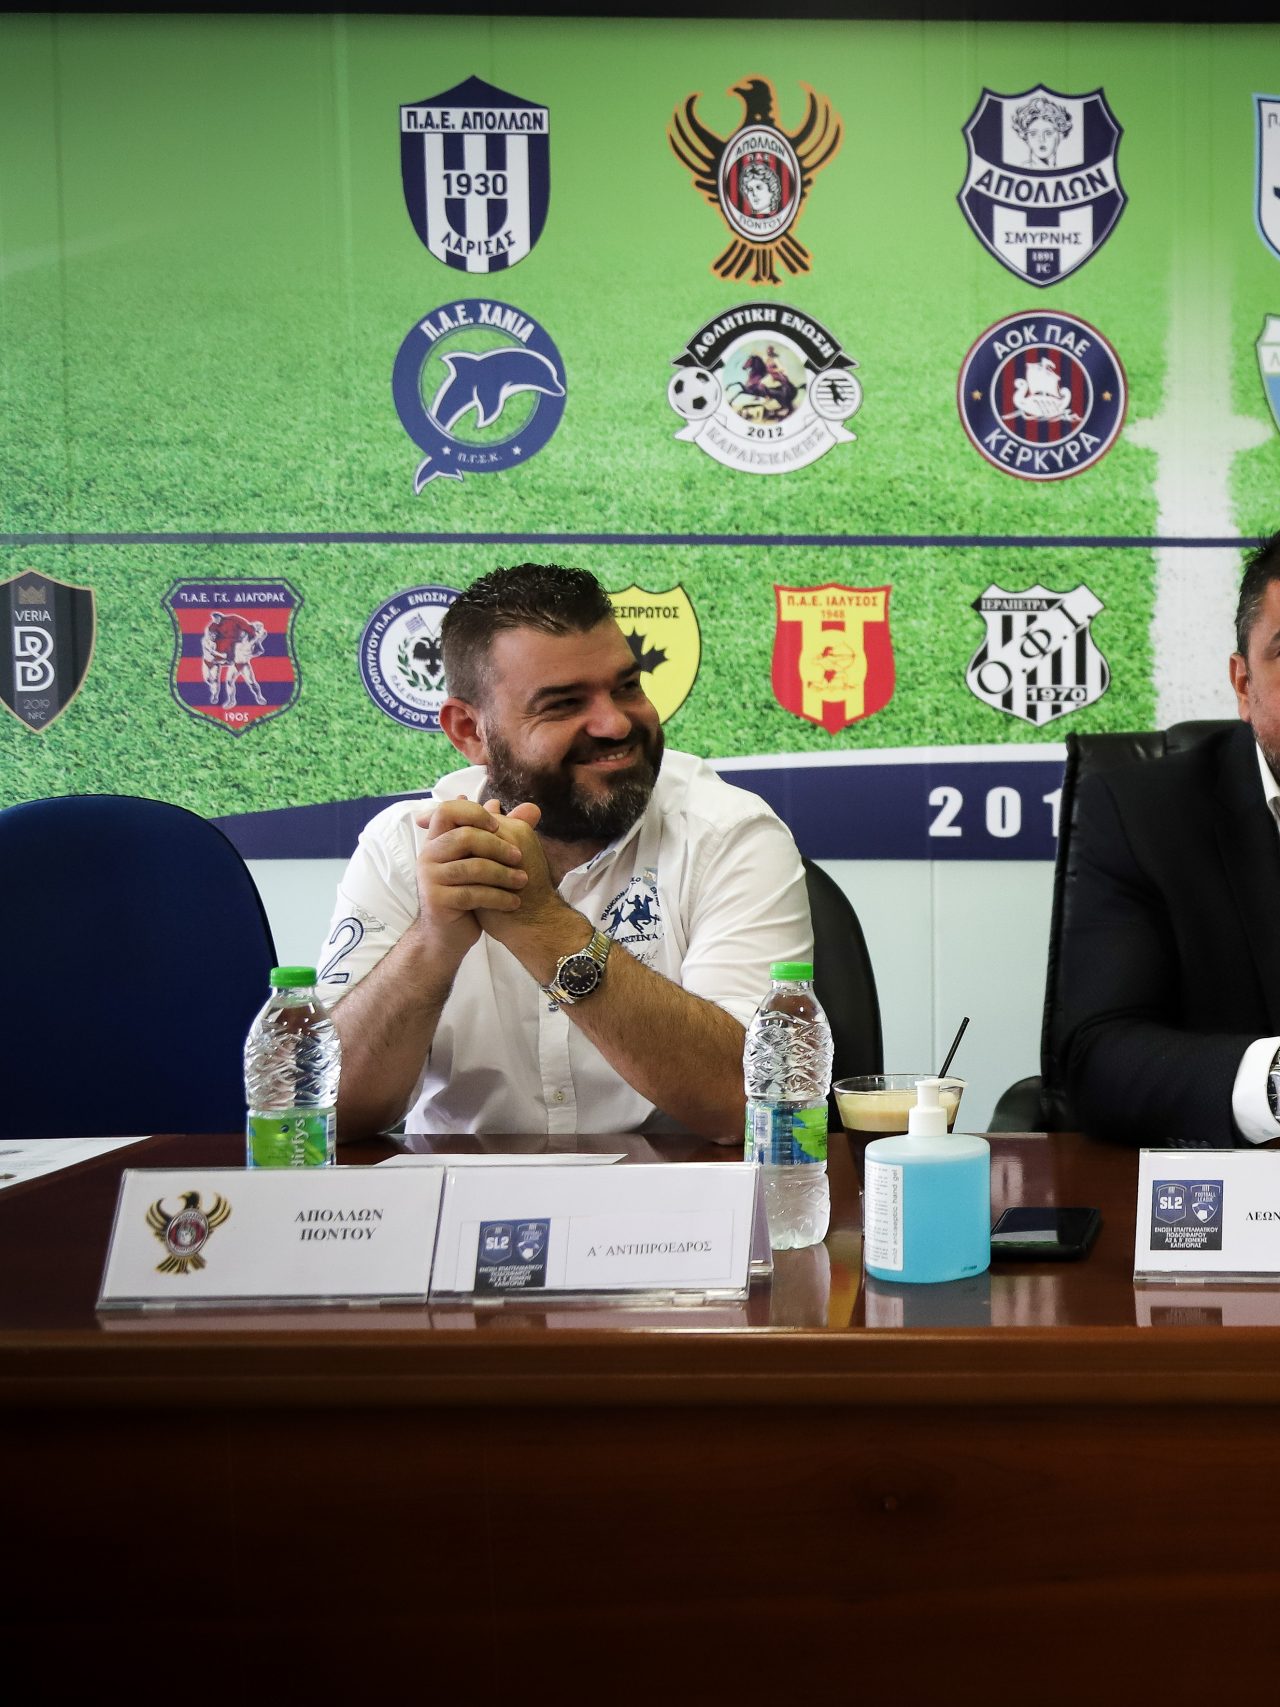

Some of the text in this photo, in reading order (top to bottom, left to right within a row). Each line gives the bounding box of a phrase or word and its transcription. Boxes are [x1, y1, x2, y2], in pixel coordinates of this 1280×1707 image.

[407, 111, 544, 130] Π.Α.Ε. ΑΠΟΛΛΩΝ
[736, 137, 785, 157] ΑΠΟΛΛΩΝ
[443, 173, 507, 196] 1930
[975, 168, 1109, 203] ΑΠΟΛΛΩΝ
[740, 215, 783, 230] ΠΟΝΤΟΥ
[442, 230, 516, 256] ΛΑΡΙΣΑΣ
[1004, 231, 1082, 245] ΣΜΥΡΝΗΣ
[420, 303, 535, 343] Π.Α.Ε. ΧΑΝΙΑ
[695, 308, 834, 359] ΑΘΛΗΤΙΚΗ ΕΝΩΣΗ
[993, 324, 1091, 360] ΑΟΚ ΠΑΕ
[747, 427, 783, 438] 2012
[984, 428, 1101, 471] ΚΕΡΚΥΡΑ
[180, 592, 210, 603] Π.Α.Ε.
[235, 592, 285, 603] ΔΙΑΓΟΡΑΣ
[407, 591, 448, 606] ΕΝΩΣΗ
[787, 595, 878, 607] Π.Α.Ε. ΙΑΛΥΣΟΣ
[981, 599, 1048, 610] ΙΕΡΑΠΕΤΡΑ
[15, 610, 51, 622] VERIA
[375, 603, 402, 630] Π.Α.Ε.
[613, 606, 680, 619] ΕΣΠΡΩΤΟΣ
[366, 630, 399, 710] ΑΣΠΡΟΠΥΡΓΟΥ
[1027, 688, 1087, 700] 1970
[224, 711, 249, 722] 1905
[398, 704, 428, 724] ΔΟΞΑ
[891, 1169, 899, 1182] gel
[1160, 1196, 1183, 1210] SL2
[295, 1208, 384, 1223] ΑΠΟΛΛΩΝ
[299, 1227, 377, 1241] ΠΟΝΤΟΥ
[485, 1236, 509, 1250] SL2
[609, 1240, 712, 1257] ΑΝΤΙΠΡΟΕΔΡΟΣ
